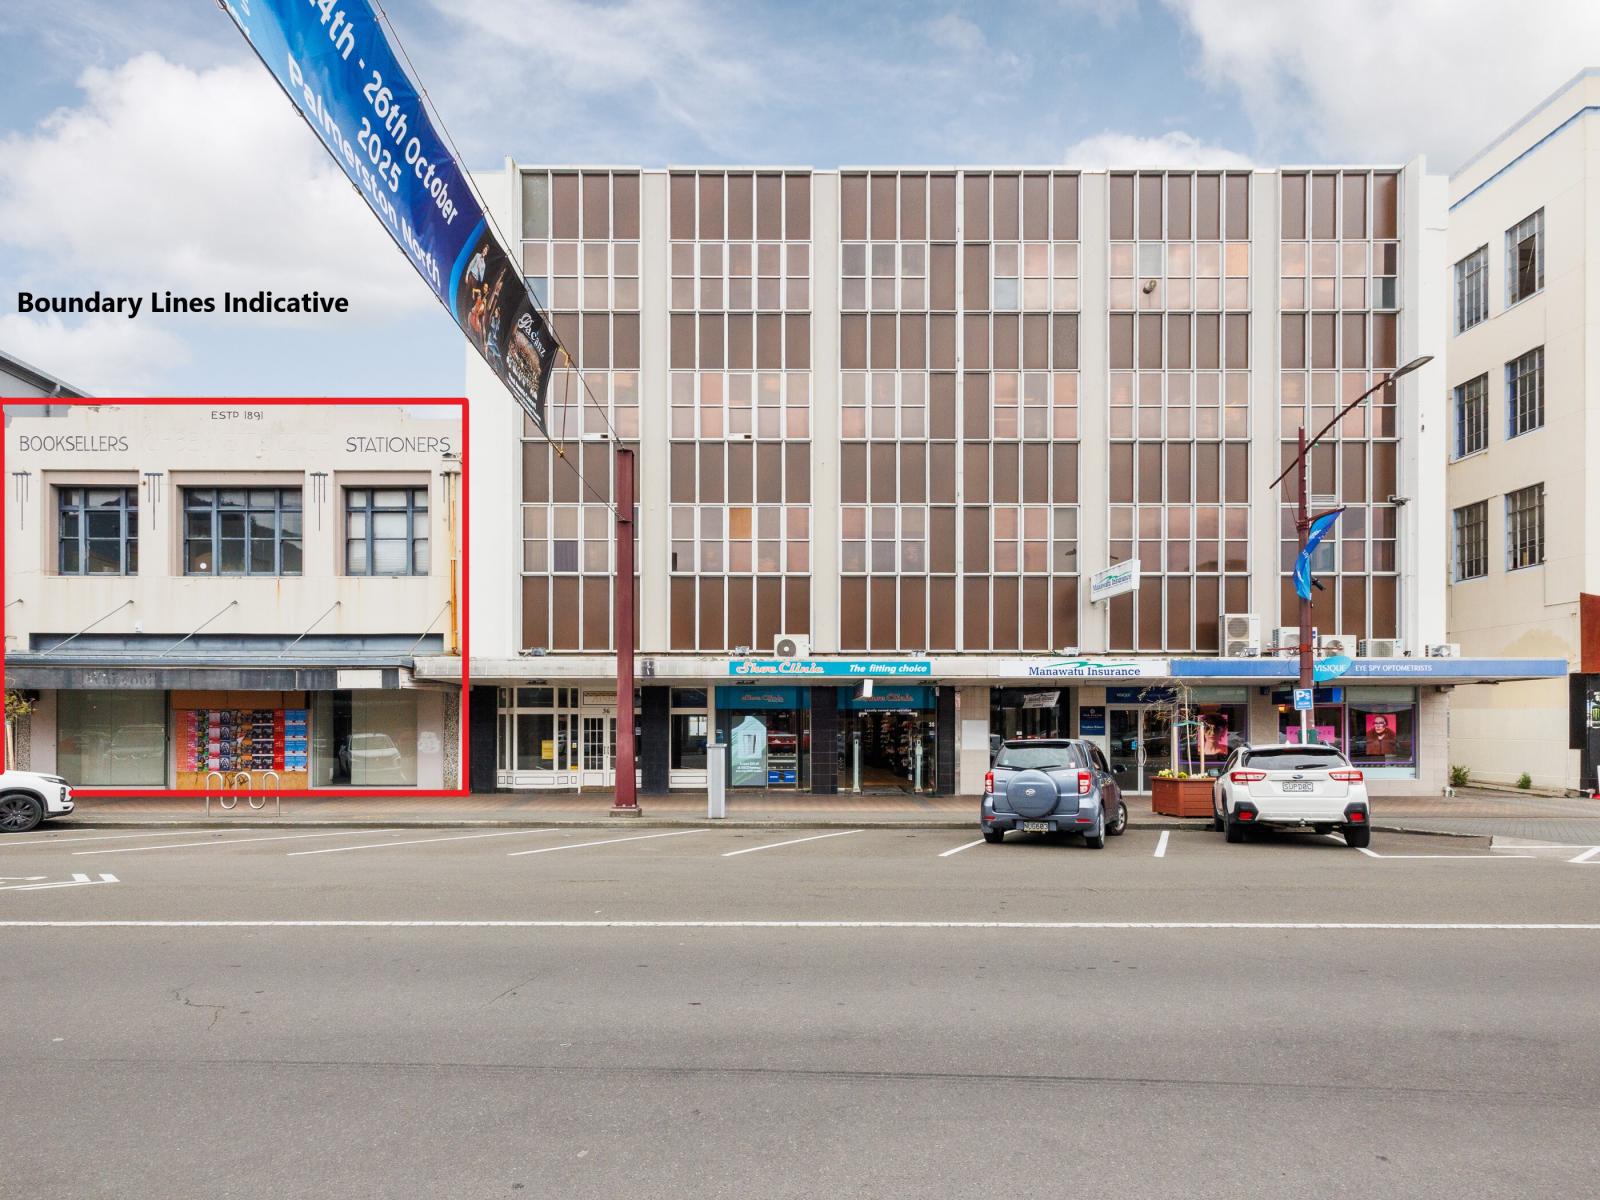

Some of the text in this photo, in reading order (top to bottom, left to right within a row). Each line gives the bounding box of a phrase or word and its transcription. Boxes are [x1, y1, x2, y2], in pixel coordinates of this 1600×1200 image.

[357, 117, 402, 192] 2025
[363, 70, 408, 145] 26th
[404, 137, 458, 225] October
[287, 52, 442, 288] Palmerston North
[211, 410, 264, 421] ESTD 1891
[19, 435, 452, 454] BOOKSELLERS STATIONERS
[735, 660, 928, 674] Shoe Clinic The fitting choice
[1029, 667, 1141, 676] Manawatu Insurance
[1314, 664, 1433, 673] VISIQUE EYE SPY OPTOMETRISTS
